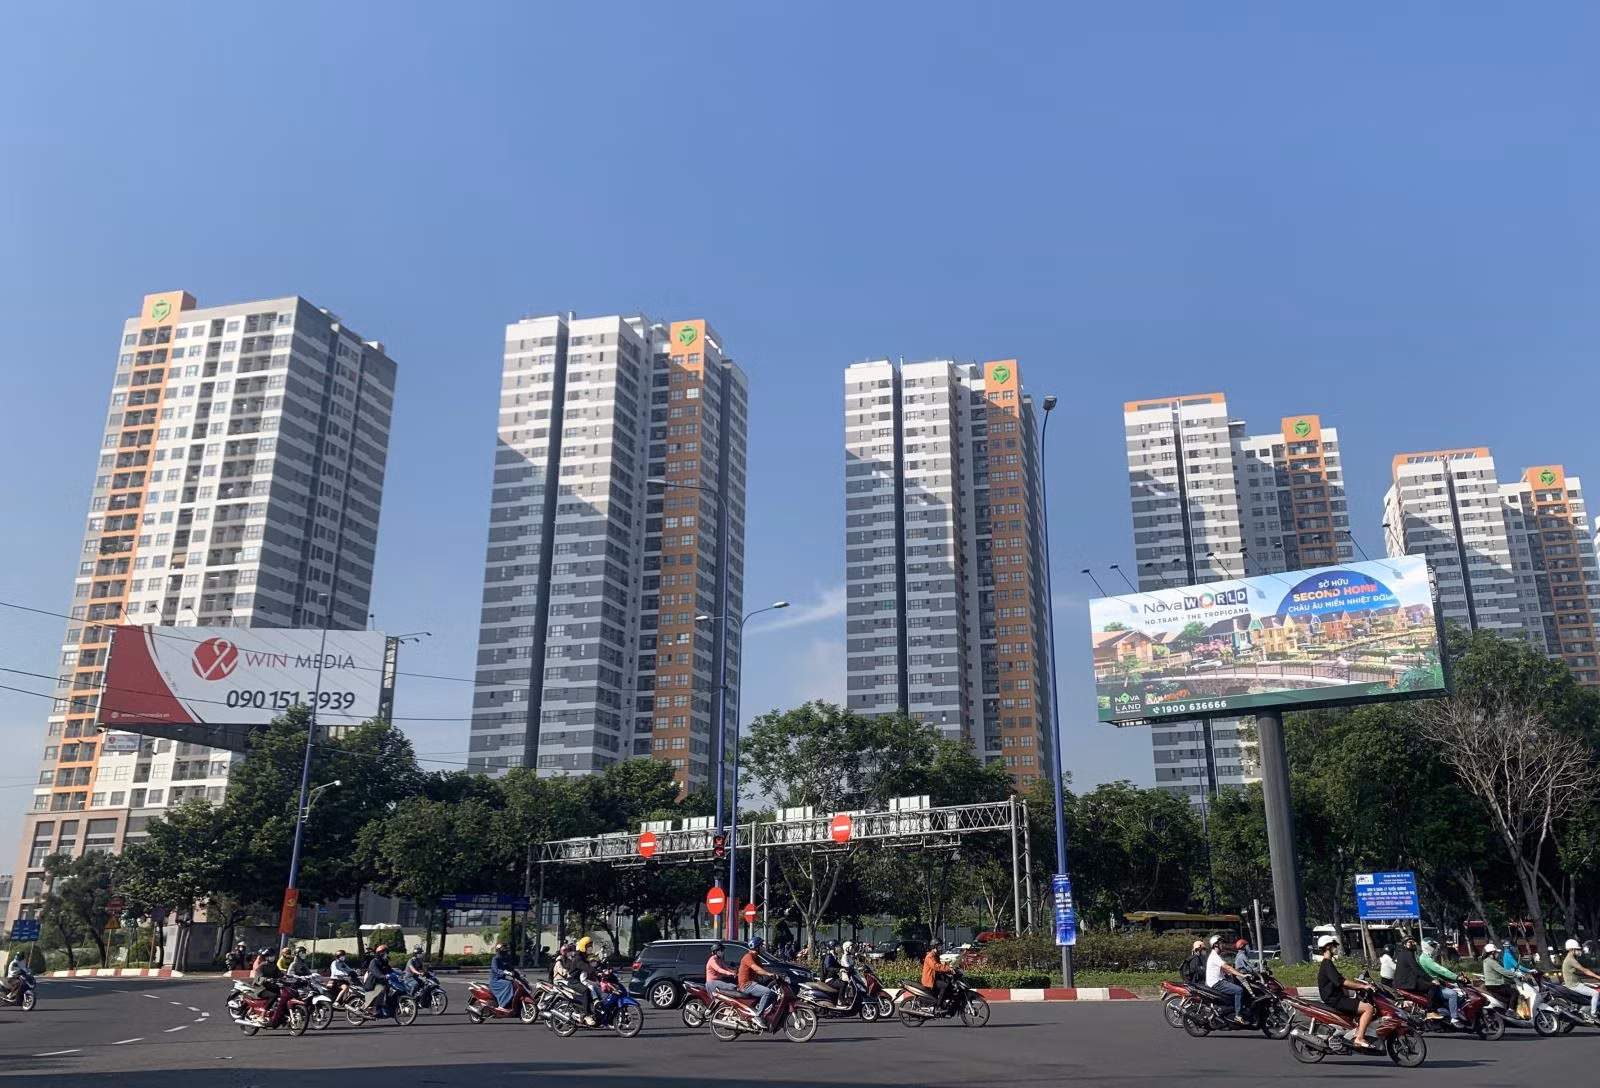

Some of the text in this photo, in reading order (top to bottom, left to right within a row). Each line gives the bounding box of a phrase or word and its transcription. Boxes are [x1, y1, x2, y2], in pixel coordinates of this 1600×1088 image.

[1293, 583, 1377, 602] SECOND HOME
[1204, 607, 1250, 619] TROPICANA
[245, 652, 355, 669] WIN MEDIA
[227, 689, 266, 708] 090
[269, 690, 300, 709] 151
[1161, 700, 1227, 713] 1900 636666
[1115, 703, 1141, 712] LAND
